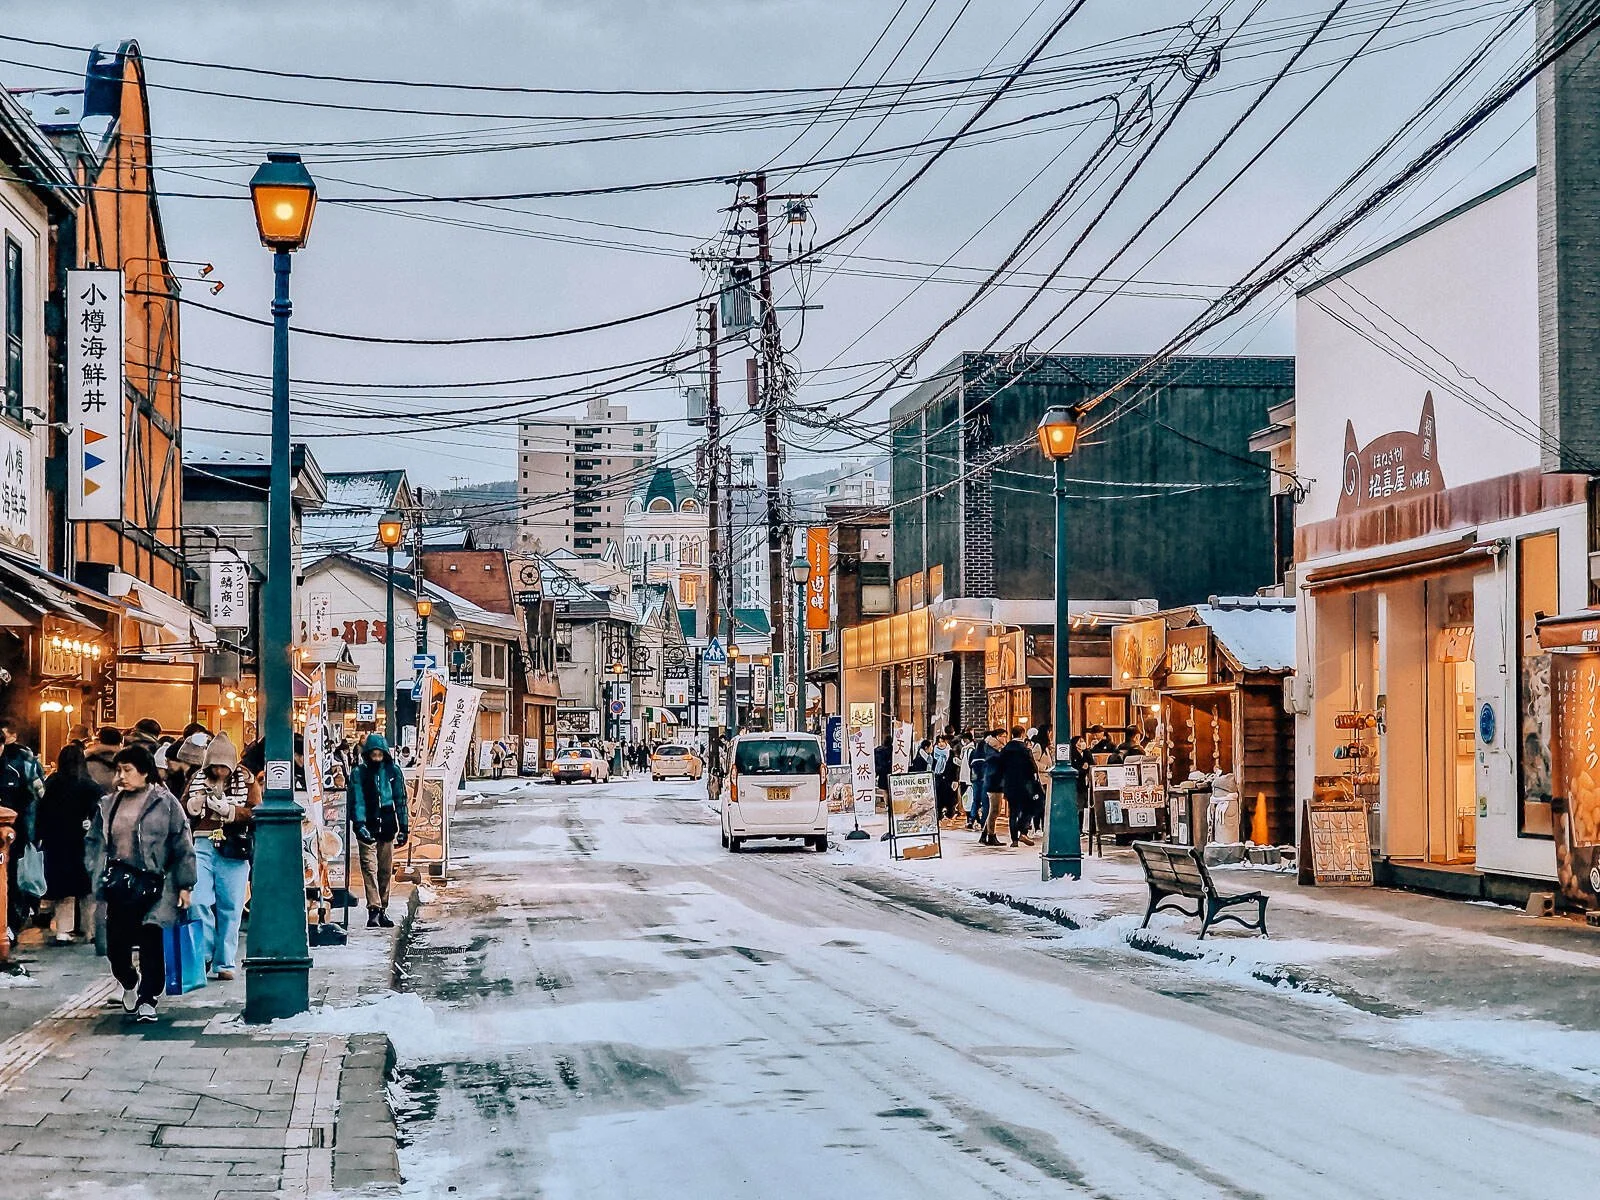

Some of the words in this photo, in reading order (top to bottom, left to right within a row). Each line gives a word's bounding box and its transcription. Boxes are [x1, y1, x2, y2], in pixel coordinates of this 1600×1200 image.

[80, 283, 108, 413] 小樽海鮮丼
[360, 704, 372, 714] P
[1584, 667, 1600, 770] カステラ
[855, 741, 873, 803] 天然石
[893, 778, 916, 787] DRINK
[917, 777, 931, 786] SET
[1122, 790, 1163, 804] 無添加
